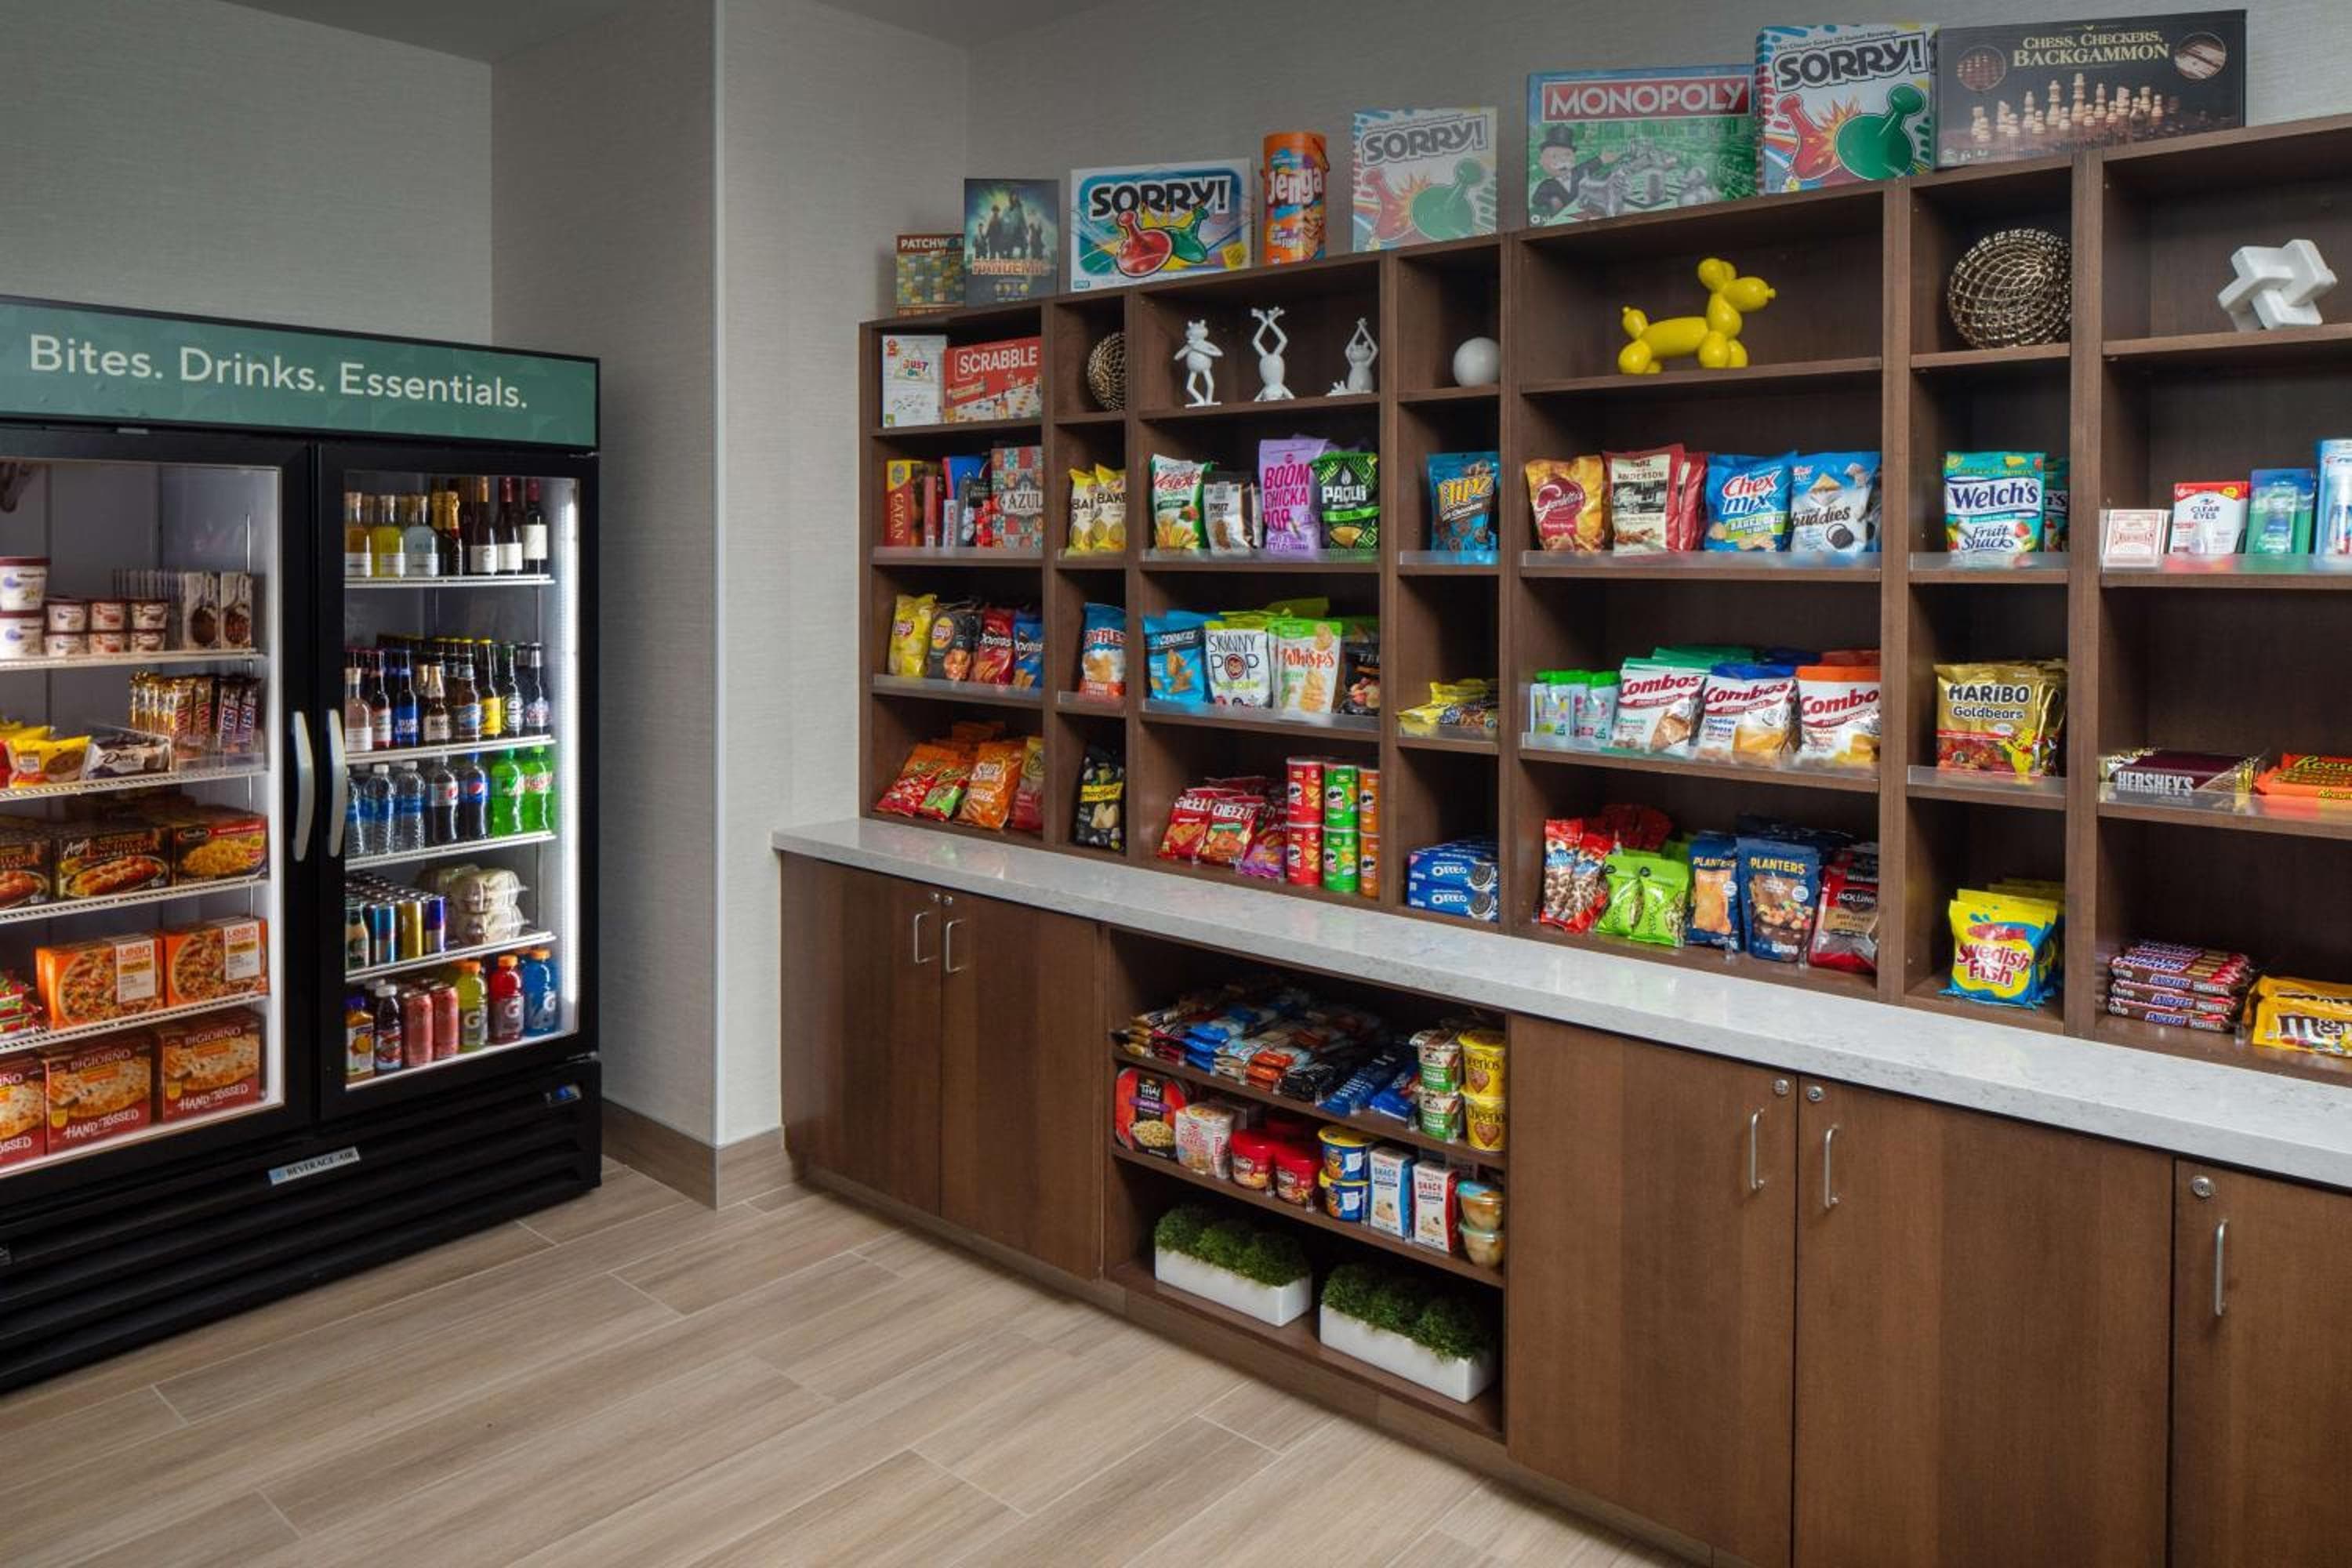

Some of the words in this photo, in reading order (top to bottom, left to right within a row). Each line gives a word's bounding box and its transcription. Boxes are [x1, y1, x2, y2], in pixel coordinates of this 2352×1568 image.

[2022, 37, 2077, 51] CHESS,
[2080, 31, 2163, 45] CHECKERS,
[1777, 38, 1924, 89] SORRY!
[2013, 43, 2170, 67] BACKGAMMON
[1548, 82, 1745, 117] MONOPOLY
[1364, 119, 1486, 163] SORRY!
[1090, 179, 1228, 217] SORRY!
[1267, 167, 1323, 205] Jenga
[29, 333, 164, 380] Bites.
[180, 347, 325, 394] Drinks.
[339, 362, 528, 409] Essentials.
[959, 346, 1039, 375] SCRABBLE
[1264, 463, 1311, 490] BOOM
[1723, 470, 1780, 497] Chex
[1007, 492, 1043, 510] AZUL
[1265, 488, 1308, 510] CHICKA
[1321, 484, 1367, 504] PAQUI
[1950, 481, 2038, 510] Welch's
[895, 492, 905, 539] CATAN
[1262, 508, 1290, 532] POP
[1792, 506, 1851, 528] buddies
[1961, 535, 2015, 552] Snacks
[1973, 524, 2010, 539] Fruit
[1208, 631, 1256, 653] SKINNY
[1210, 653, 1261, 680] POP
[1618, 673, 1700, 699] Combos
[1705, 682, 1789, 705] Combos
[1948, 684, 2030, 703] HARIBO
[1800, 688, 1879, 715] Combo
[1953, 706, 2024, 720] Goldbears
[2117, 770, 2195, 796] HERSHEY'S
[1432, 865, 1468, 877] OREO
[1750, 857, 1806, 875] PLANTERS
[1432, 893, 1468, 905] OREO
[1956, 943, 2031, 971] Swedish
[1968, 959, 2014, 986] Fish
